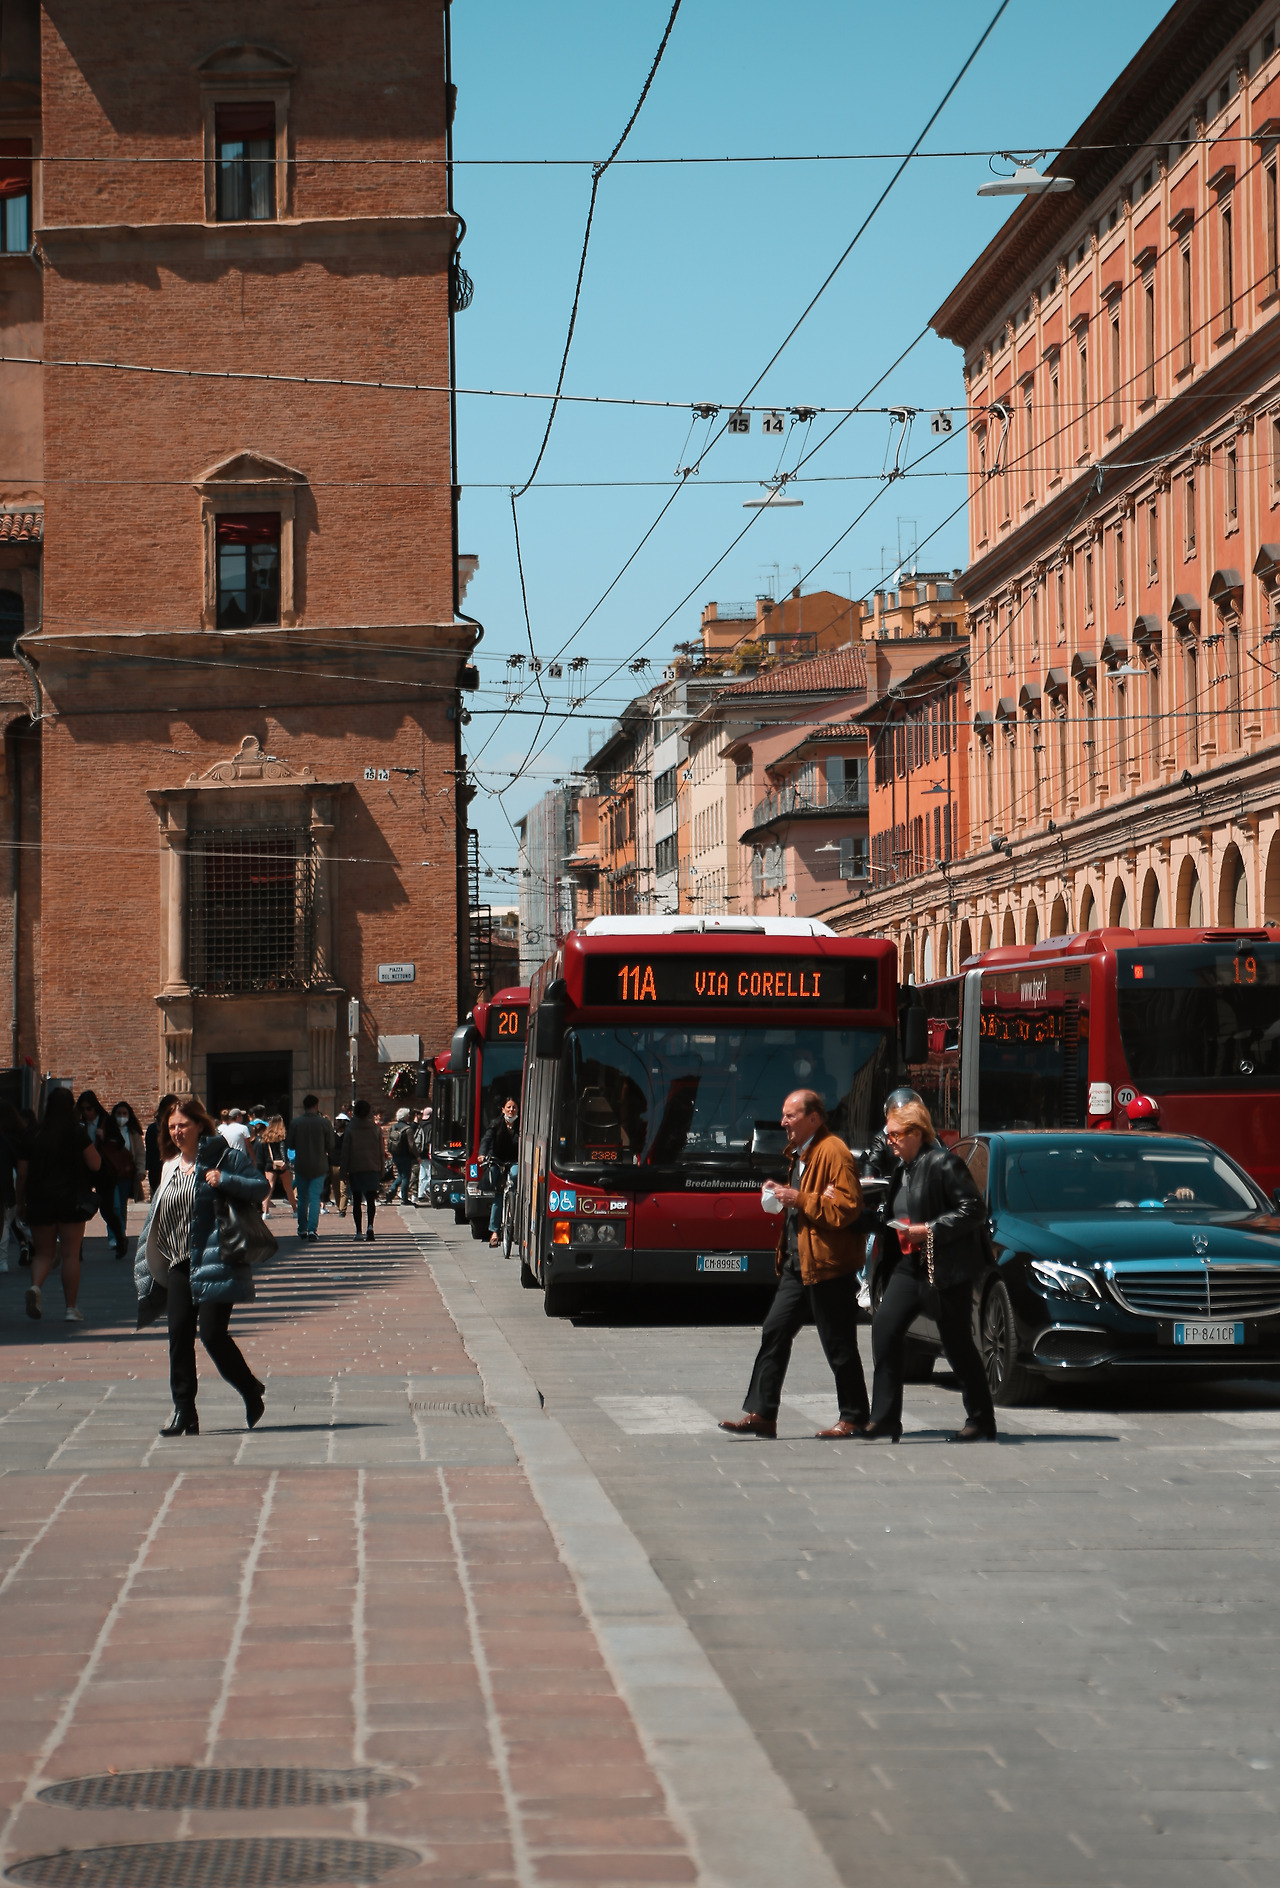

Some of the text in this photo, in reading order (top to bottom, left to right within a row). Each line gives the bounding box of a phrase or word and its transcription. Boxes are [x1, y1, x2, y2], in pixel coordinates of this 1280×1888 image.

[730, 419, 749, 431] 15
[763, 419, 783, 432] 14
[931, 419, 952, 432] 13
[529, 662, 541, 671] 15
[549, 668, 562, 677] 14
[662, 670, 675, 679] 13
[1232, 956, 1257, 984] 19
[617, 965, 821, 1001] 11A VIA CORELLI
[498, 1011, 518, 1034] 20
[1121, 1092, 1132, 1103] 70
[591, 1151, 617, 1160] 2328
[685, 1179, 765, 1188] BredaMenarinibu
